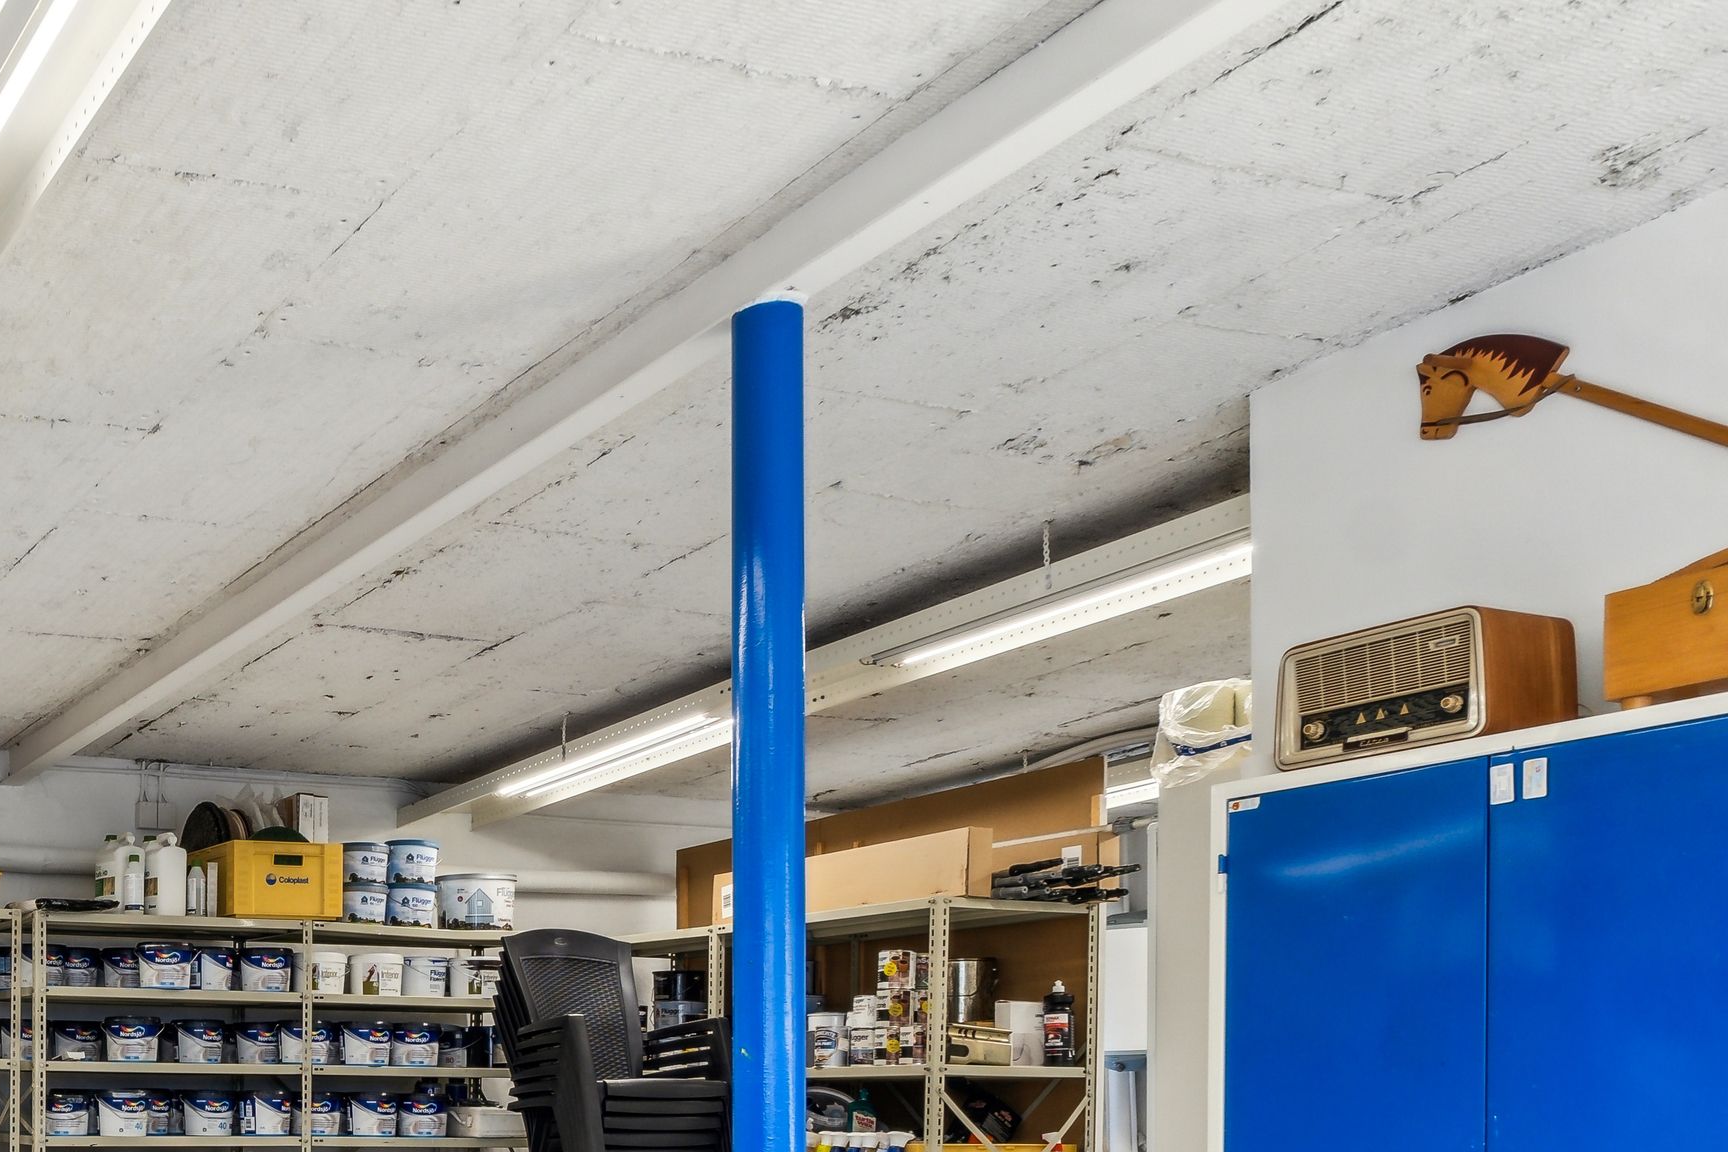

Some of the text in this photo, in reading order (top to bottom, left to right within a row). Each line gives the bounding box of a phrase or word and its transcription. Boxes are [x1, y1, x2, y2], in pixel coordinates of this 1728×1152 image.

[279, 876, 309, 885] Coloplast
[155, 957, 179, 965] Nordsjö
[261, 962, 284, 970] Nordsjö
[405, 1036, 429, 1044] Nordsjö
[311, 1106, 331, 1114] ordsjö
